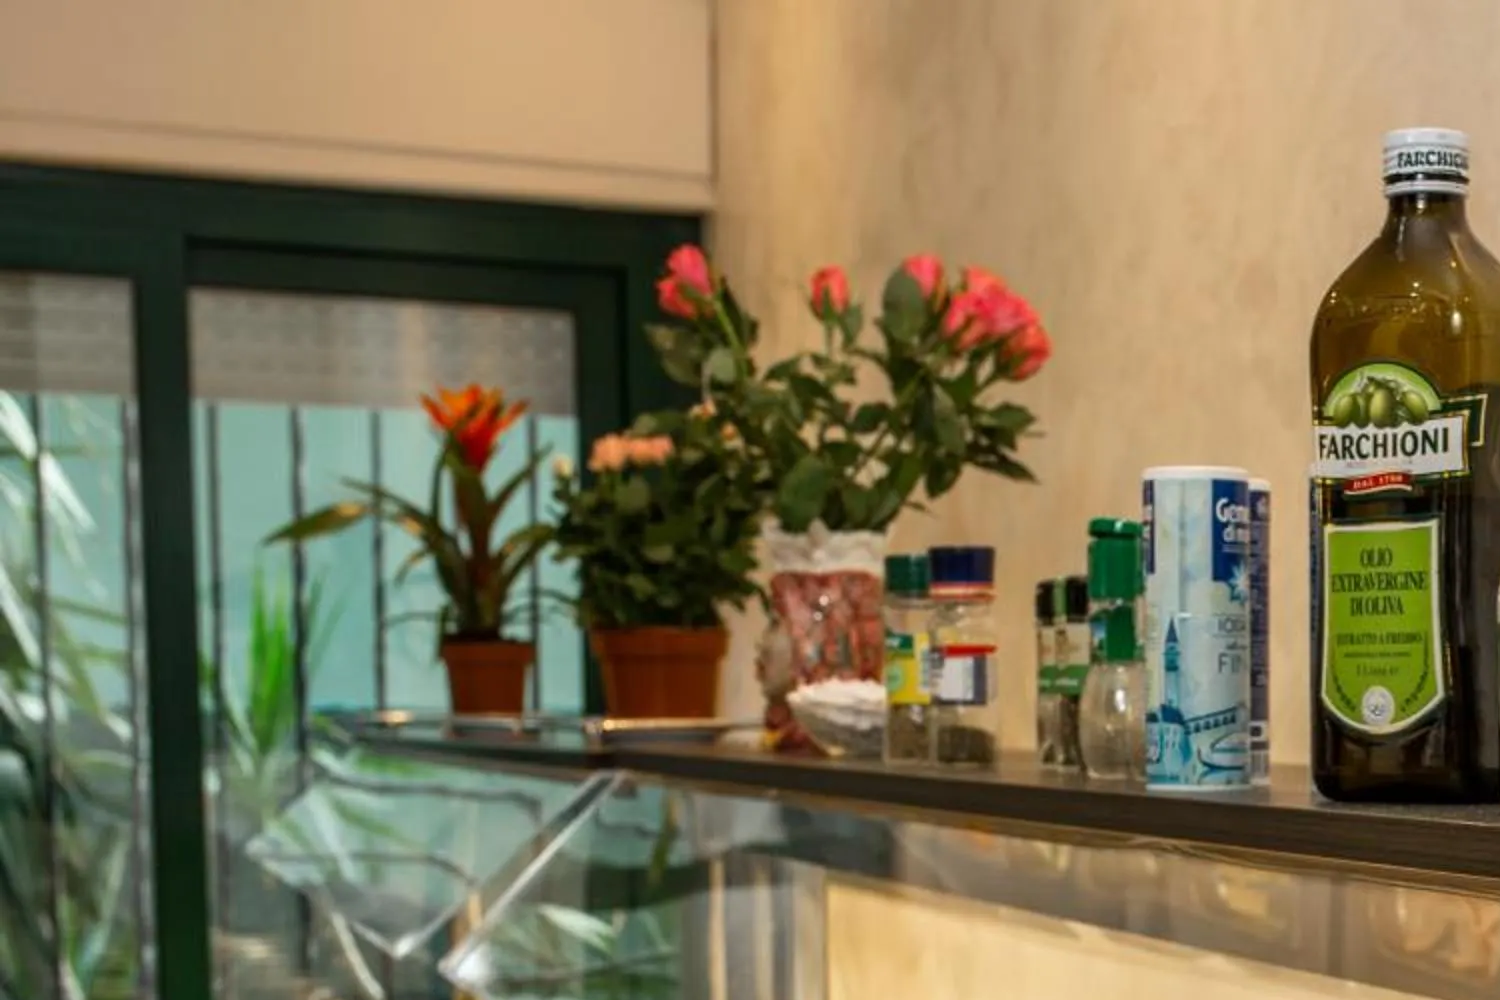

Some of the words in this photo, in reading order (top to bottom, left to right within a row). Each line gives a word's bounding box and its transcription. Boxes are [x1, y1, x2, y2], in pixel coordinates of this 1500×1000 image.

[1318, 427, 1449, 461] FARCHIONI
[1359, 547, 1393, 568] OLIO
[1331, 569, 1428, 593] EXTRAVERGINE
[1364, 595, 1405, 616] OLIVA
